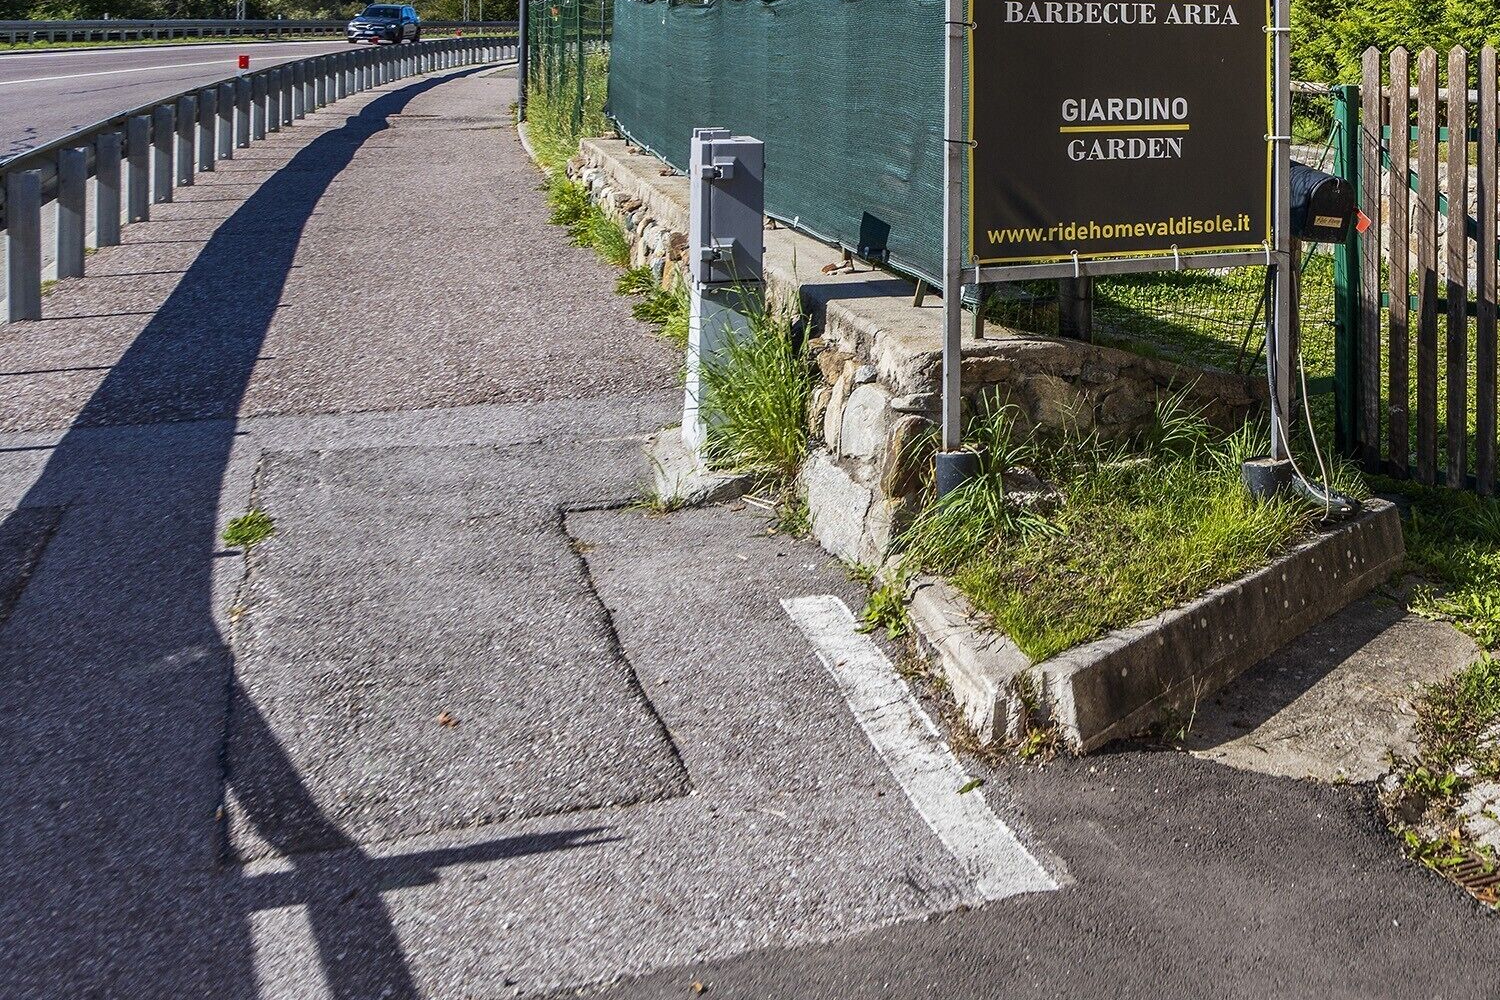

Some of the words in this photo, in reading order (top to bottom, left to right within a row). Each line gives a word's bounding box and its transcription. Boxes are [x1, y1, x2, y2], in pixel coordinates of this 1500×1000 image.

[1004, 1, 1157, 25] BARBECUE
[1164, 3, 1239, 25] AREA
[1061, 97, 1189, 122] GIARDINO
[1067, 137, 1183, 162] GARDEN
[987, 215, 1250, 244] www.ridehomevaldisole.it
